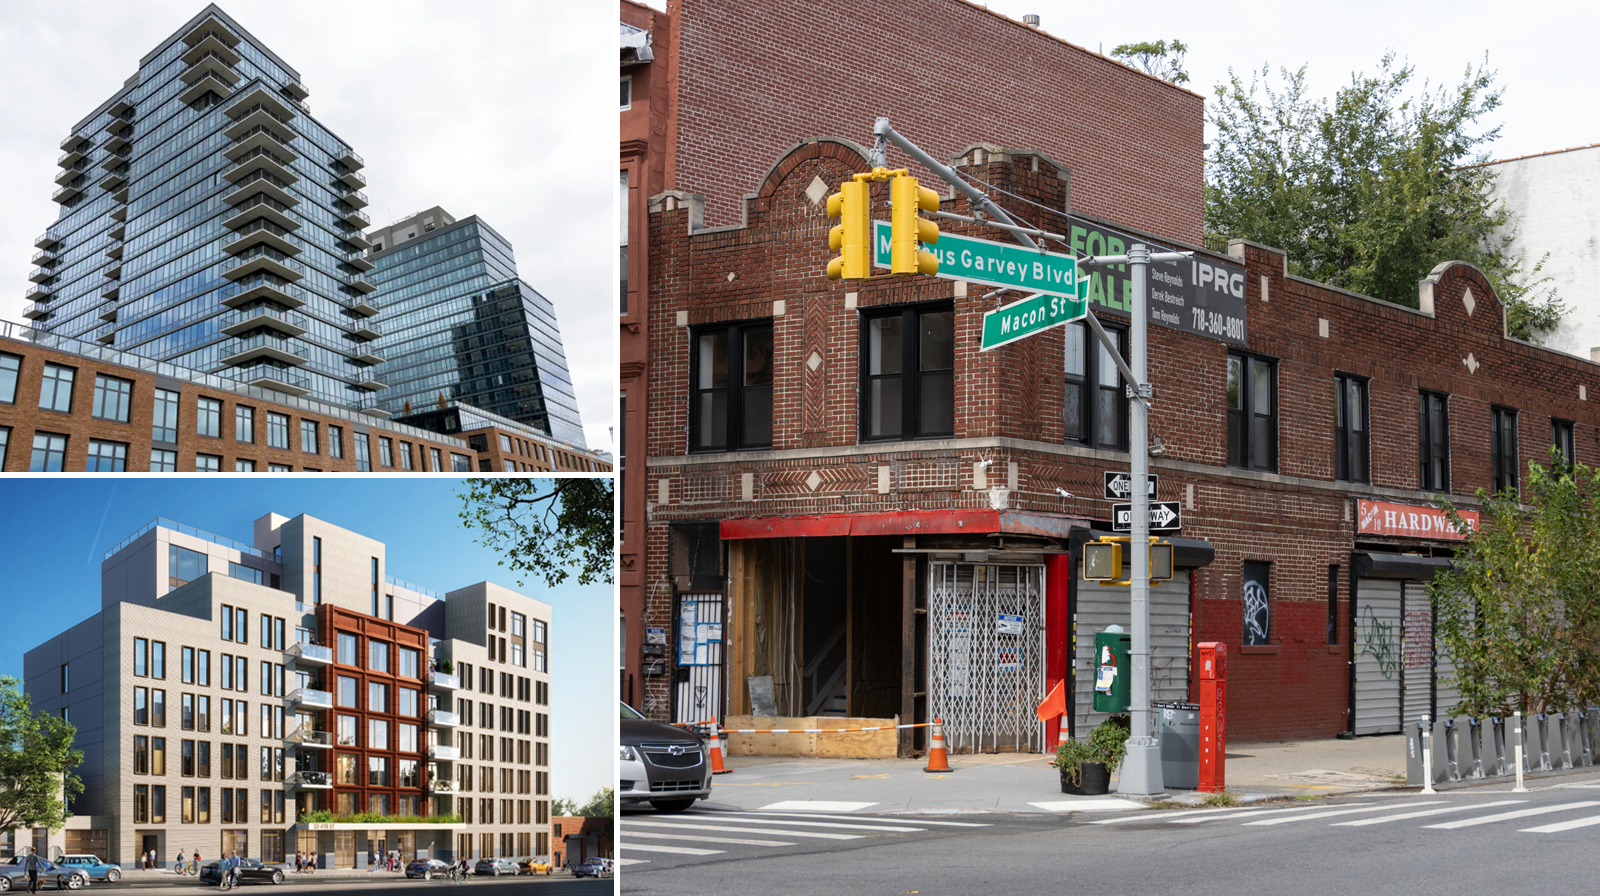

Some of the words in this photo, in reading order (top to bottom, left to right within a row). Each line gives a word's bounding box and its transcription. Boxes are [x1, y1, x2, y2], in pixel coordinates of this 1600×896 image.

[881, 234, 955, 266] Mus
[961, 249, 1027, 282] Garvey
[1033, 261, 1073, 286] Blvd
[1070, 225, 1126, 273] FOR
[1078, 266, 1132, 313] ALE
[1151, 268, 1164, 282] Steve
[1164, 271, 1184, 287] Reynolds
[1192, 260, 1244, 299] IPRG
[1151, 287, 1164, 301] Derek
[1001, 306, 1046, 336] Macon
[1050, 297, 1066, 318] St
[1151, 307, 1160, 320] Tom
[1161, 309, 1180, 325] Reynolds
[1192, 306, 1245, 341] 718-360-8801
[1113, 480, 1129, 492] ONE
[1150, 510, 1170, 521] WAY
[1360, 502, 1367, 516] 5
